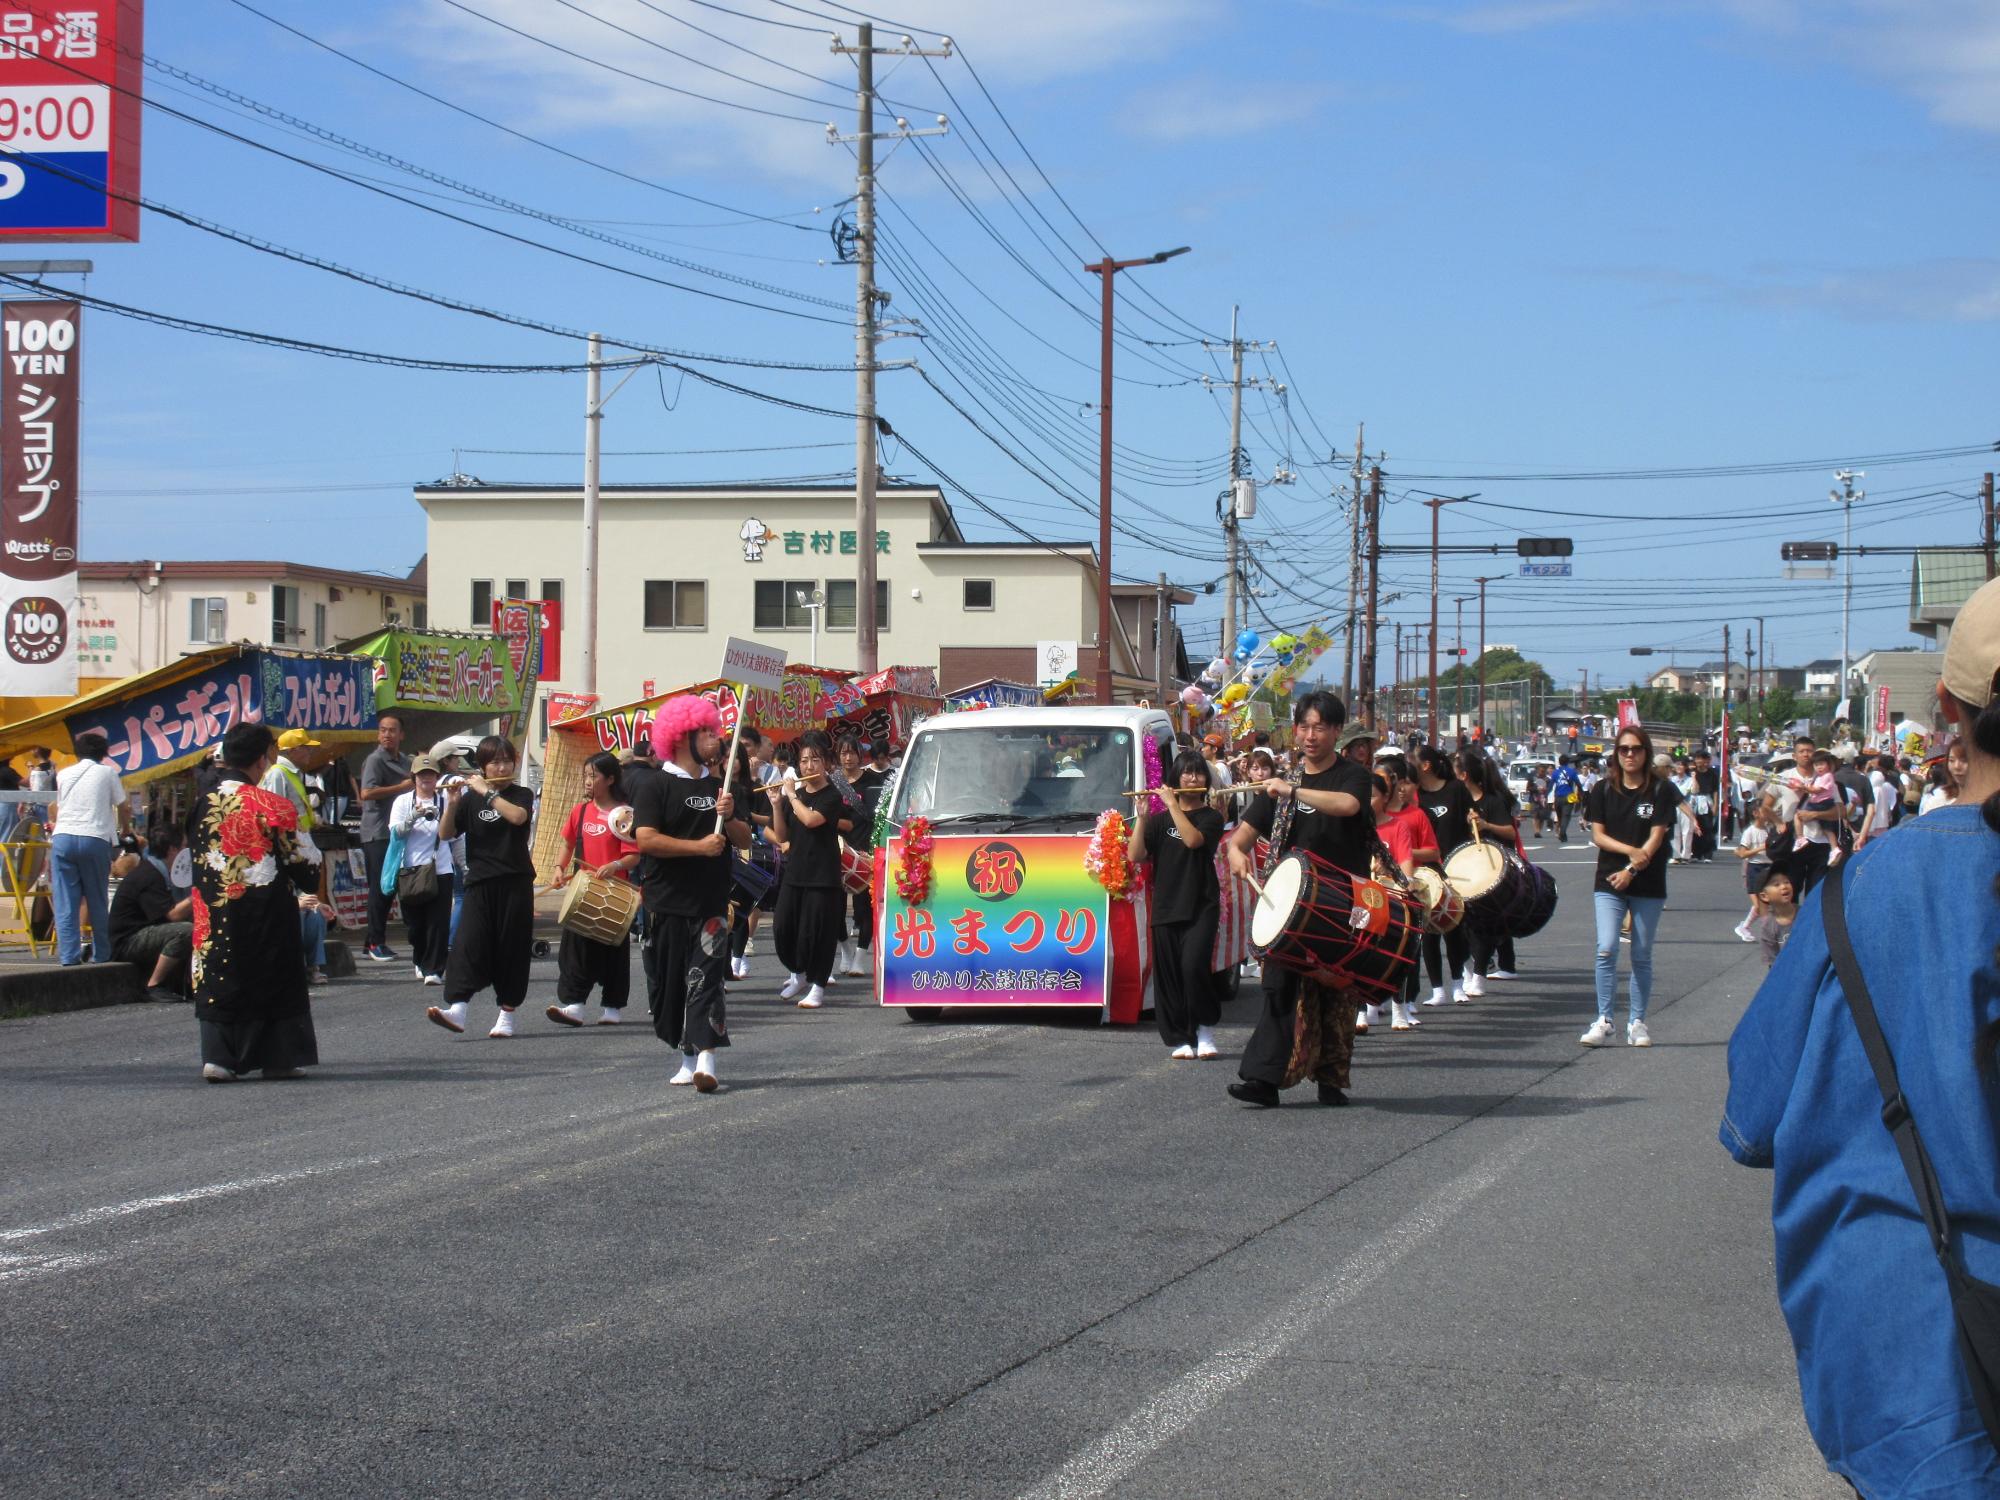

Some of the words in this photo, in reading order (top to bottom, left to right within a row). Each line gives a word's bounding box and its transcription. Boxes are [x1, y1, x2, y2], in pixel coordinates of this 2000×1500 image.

[0, 12, 98, 59] 品・酒
[5, 320, 75, 351] 100
[11, 355, 65, 375] YEN
[18, 383, 60, 523] ショップ
[5, 539, 51, 554] Watts
[13, 613, 58, 635] 100
[9, 635, 28, 659] YEN
[31, 635, 62, 661] SHOP
[726, 648, 784, 677] ひかり太鼓保存会
[286, 672, 361, 728] スーパーボール
[972, 850, 1019, 895] 祝
[892, 907, 1097, 959] 光まつり
[911, 968, 1082, 992] ひかり太鼓保存会
